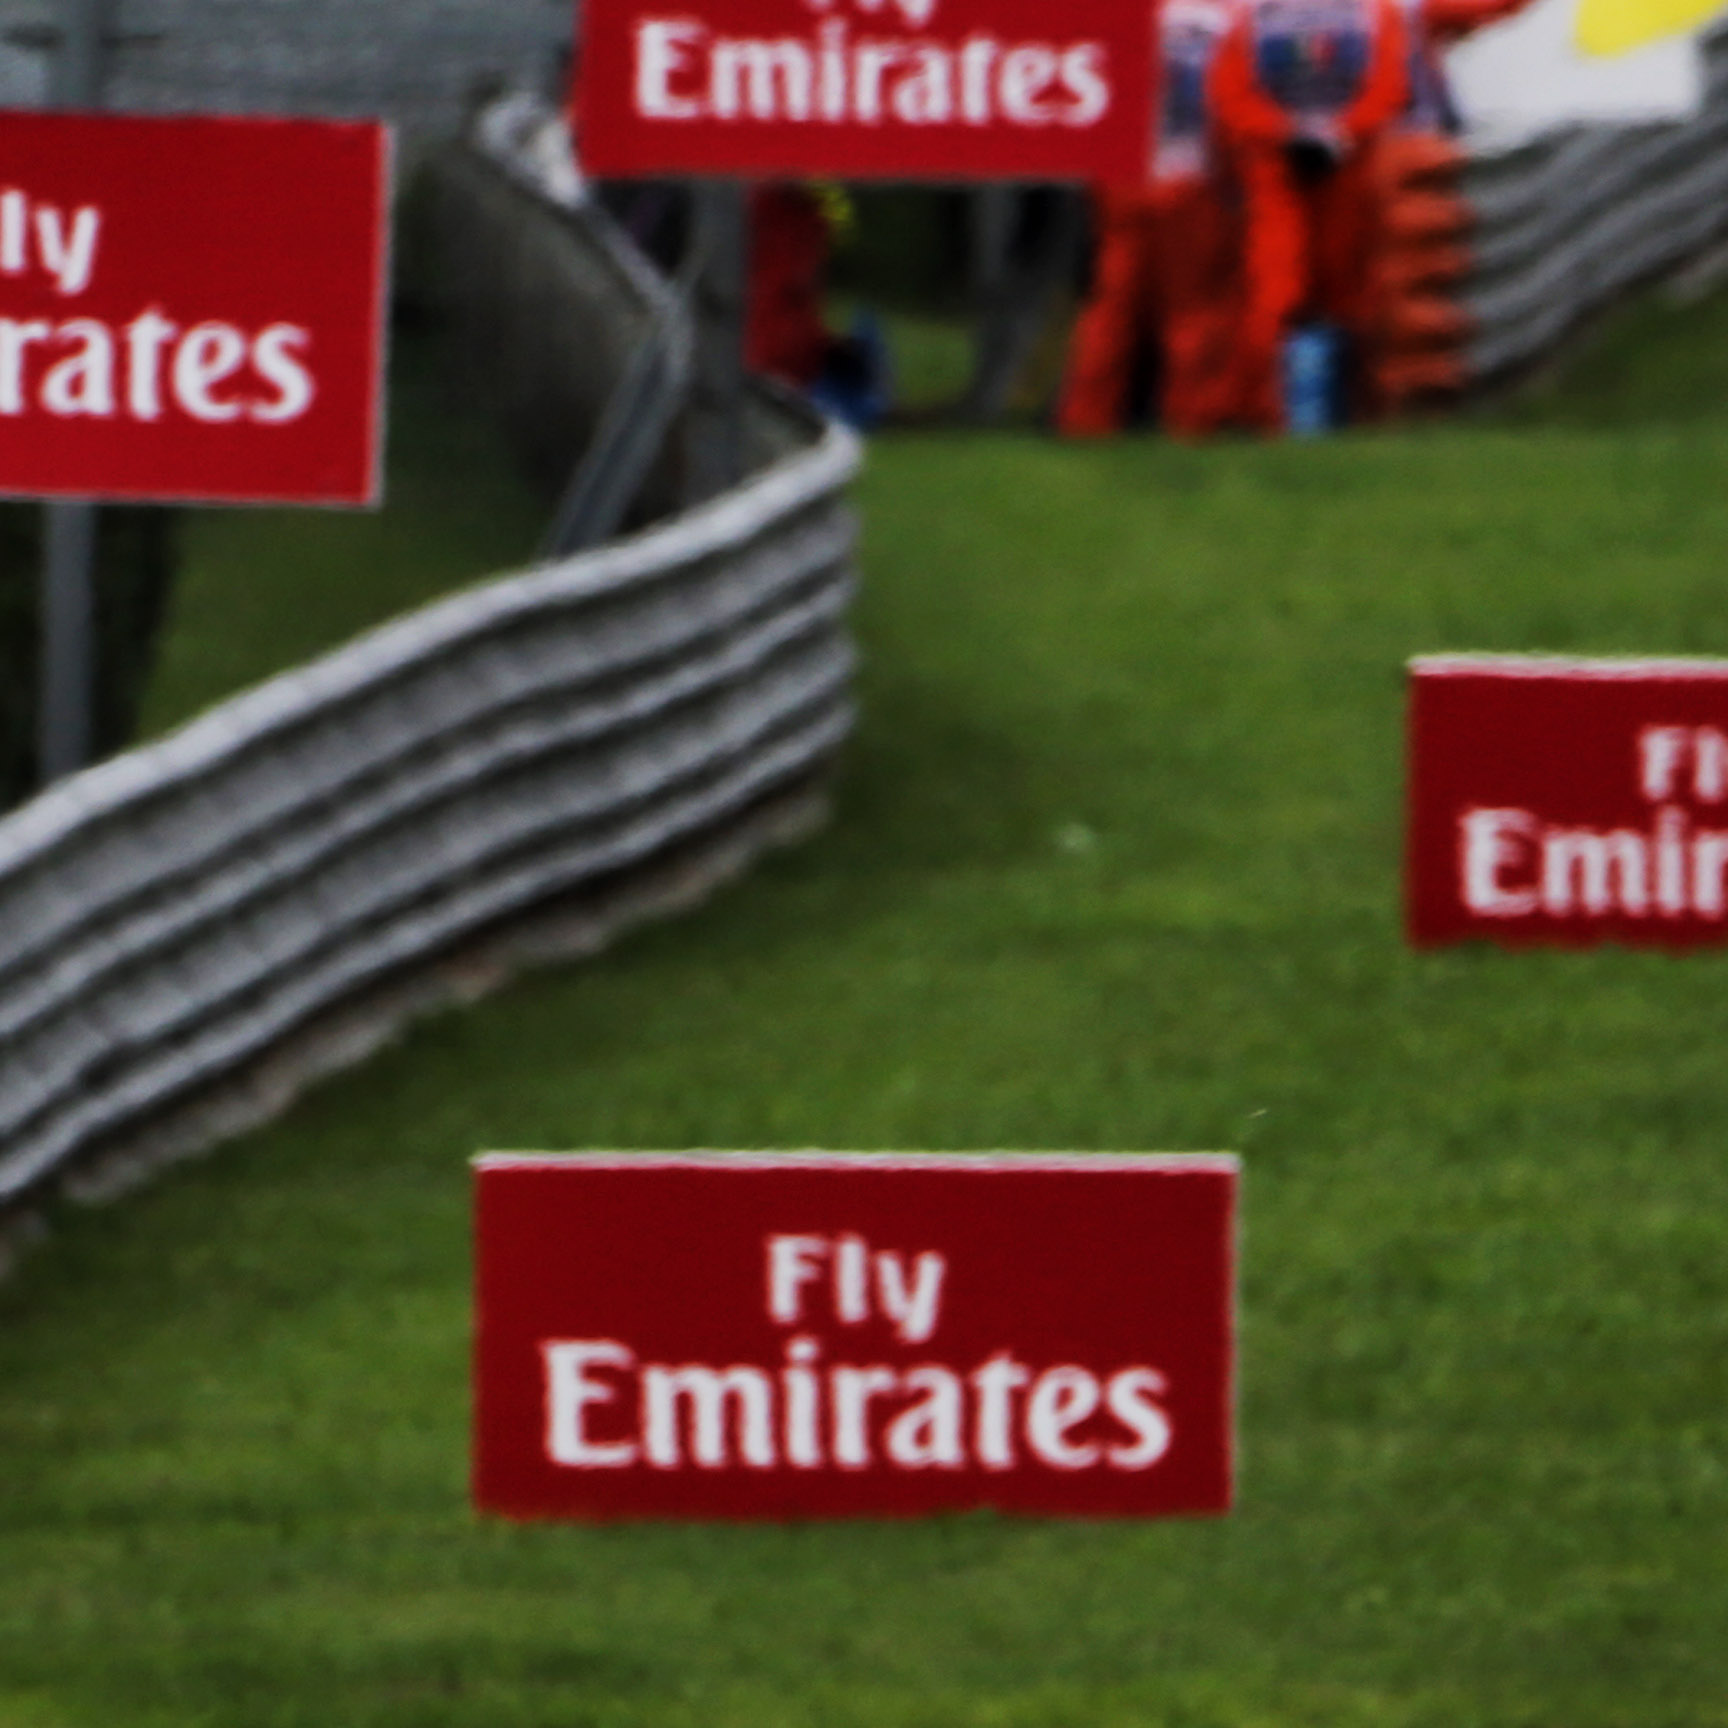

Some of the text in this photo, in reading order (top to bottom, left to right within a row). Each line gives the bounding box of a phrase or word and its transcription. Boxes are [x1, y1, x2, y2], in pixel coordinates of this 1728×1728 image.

[636, 16, 1110, 127] Emirates
[767, 1232, 946, 1343] Fly
[542, 1335, 1171, 1471] Emirates
